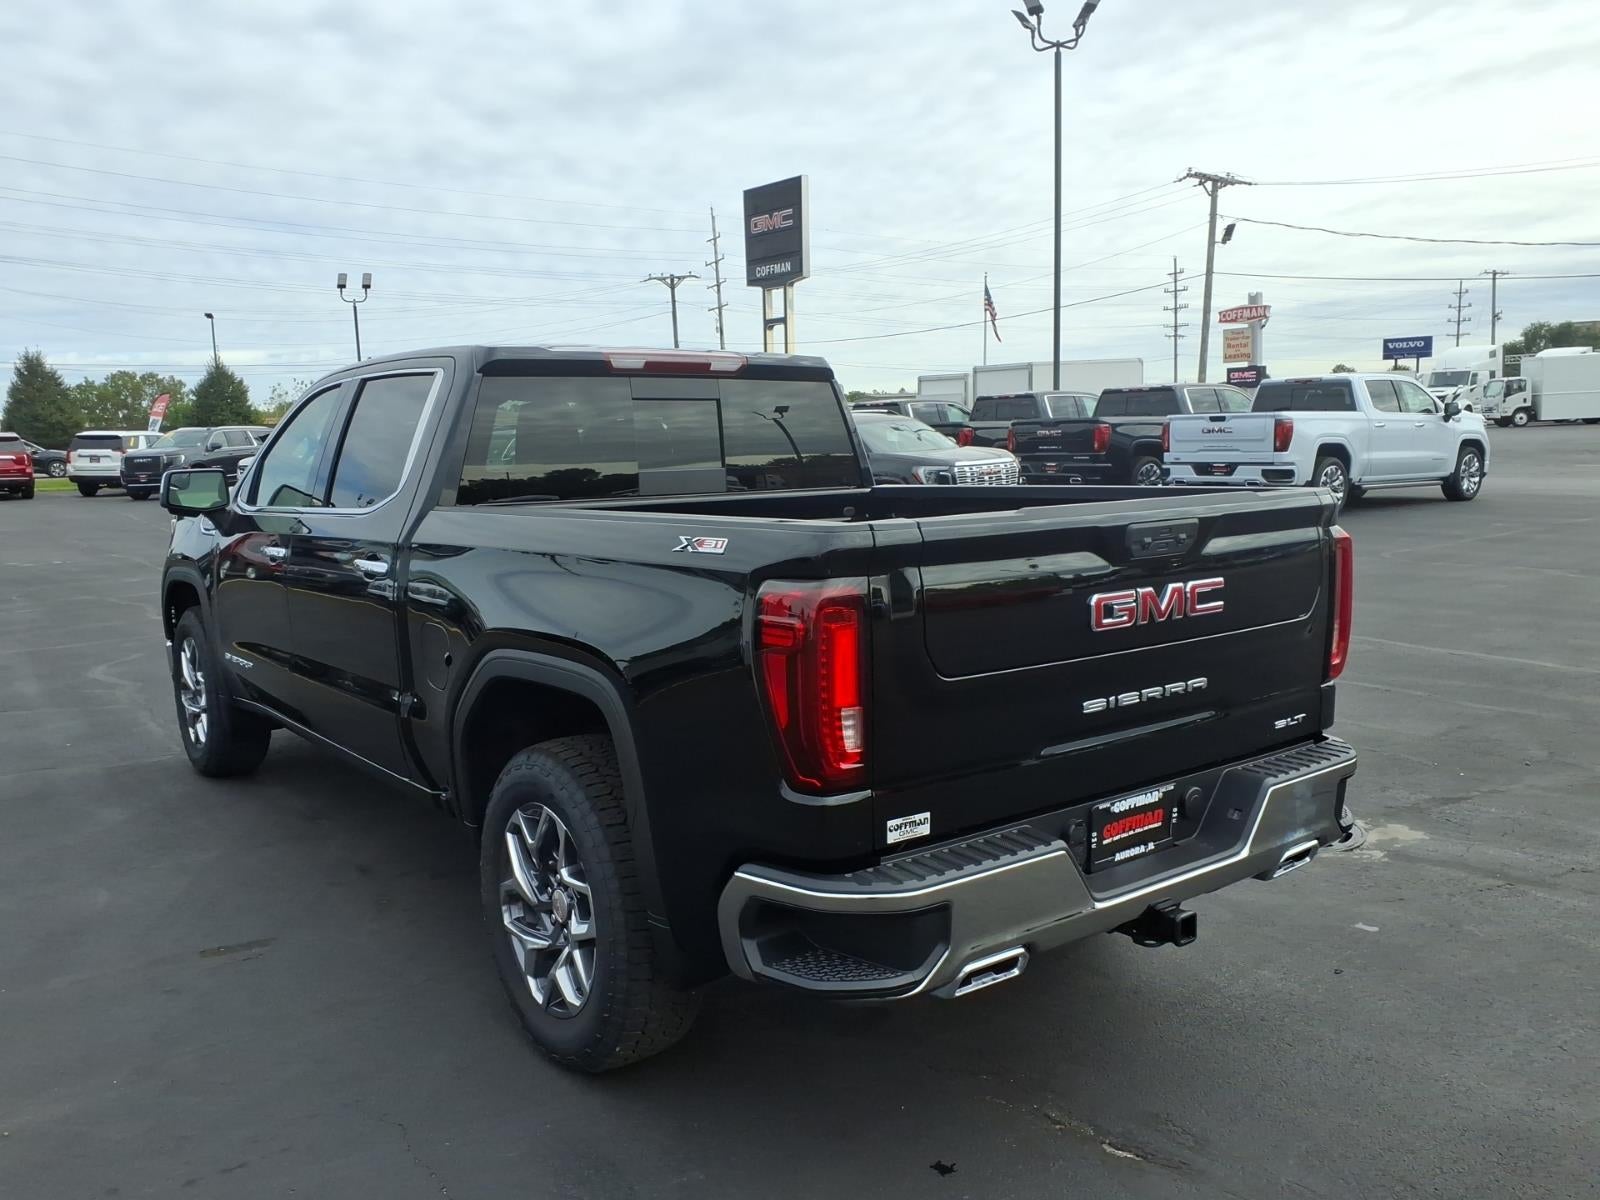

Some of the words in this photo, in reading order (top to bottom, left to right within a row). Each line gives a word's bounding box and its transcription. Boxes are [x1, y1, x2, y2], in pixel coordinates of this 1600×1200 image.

[751, 209, 793, 234] GMC
[756, 261, 791, 277] COFFMAN
[1221, 308, 1264, 320] COFFMAN
[1387, 340, 1424, 349] VOLVO
[1089, 577, 1225, 632] GMC
[1083, 677, 1208, 714] SIERRA
[1274, 713, 1307, 729] SLT
[888, 817, 929, 832] COFFMAN
[1103, 808, 1164, 838] COFFMAN
[899, 828, 918, 836] GMC
